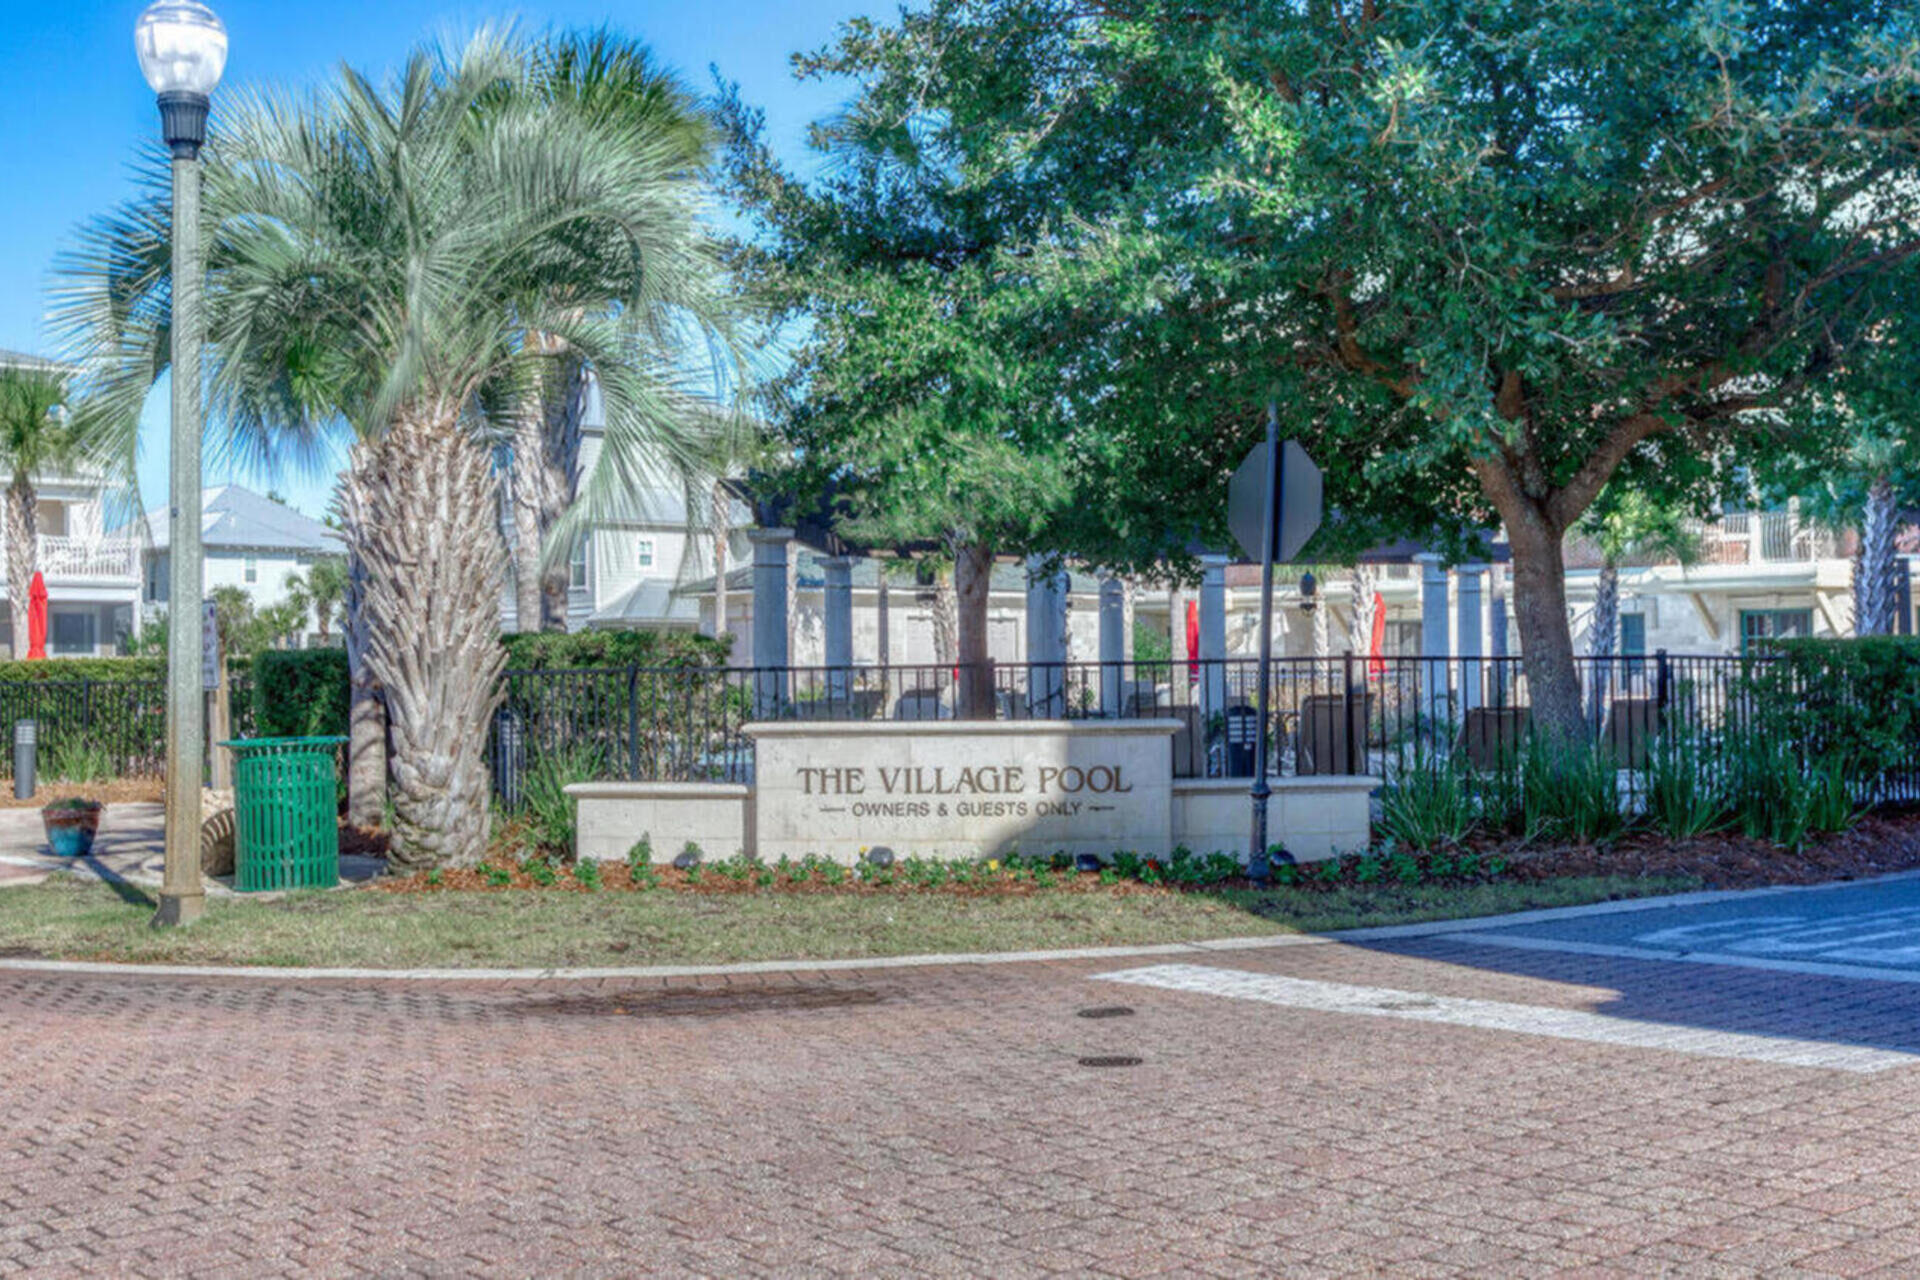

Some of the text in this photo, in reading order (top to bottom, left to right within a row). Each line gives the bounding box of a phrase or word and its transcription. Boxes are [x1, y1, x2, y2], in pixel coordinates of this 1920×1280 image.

[797, 765, 1134, 795] THE VILLAGE POOL
[852, 802, 1082, 818] OWNERS & GUESTS ONLY
